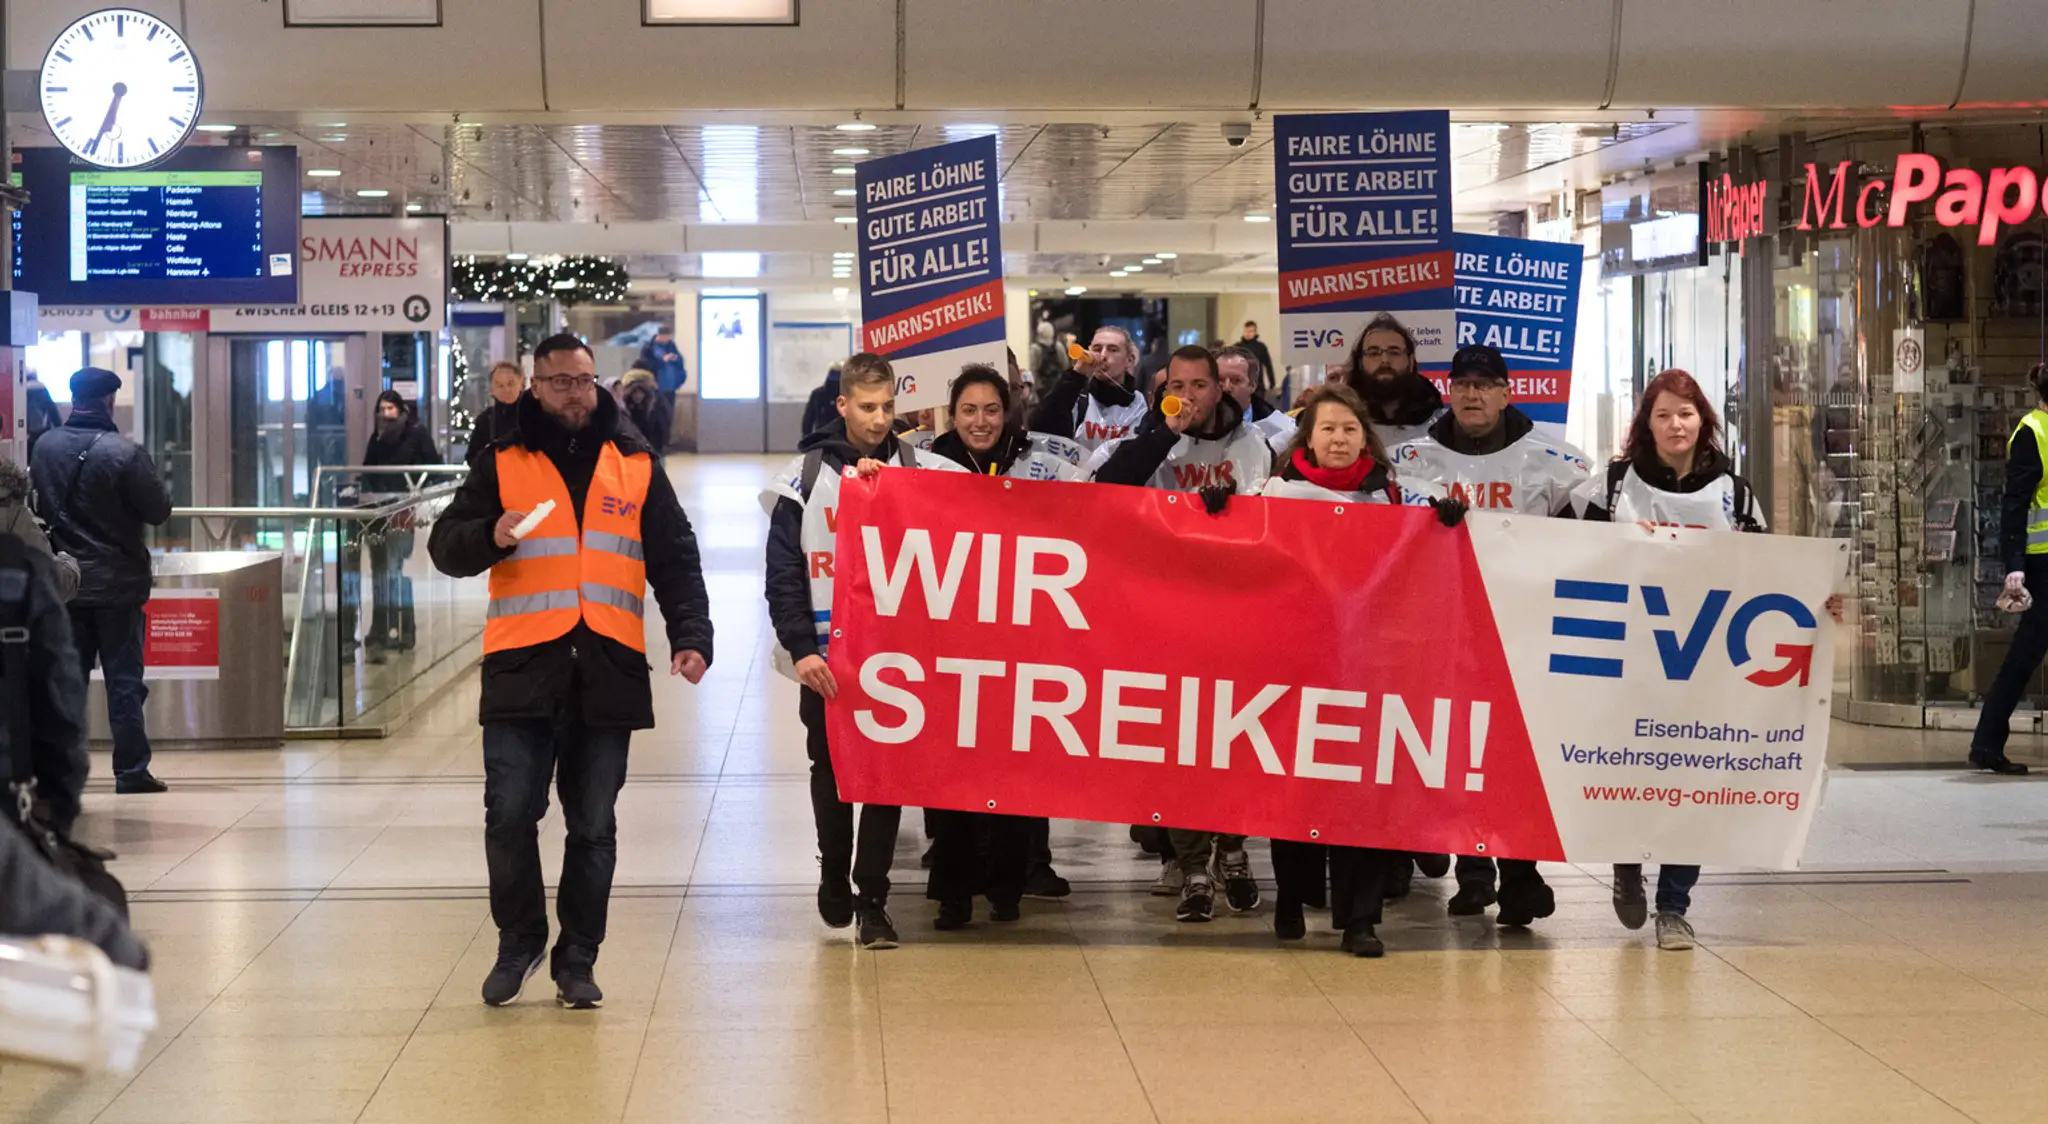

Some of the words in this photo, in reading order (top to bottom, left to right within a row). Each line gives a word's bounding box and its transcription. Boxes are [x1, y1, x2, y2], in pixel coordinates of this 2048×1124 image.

[1288, 135, 1351, 156] FAIRE
[1358, 128, 1436, 154] LÖHNE
[166, 186, 203, 194] Paderborn
[866, 173, 916, 204] FAIRE
[921, 159, 985, 192] LÖHNE
[1288, 172, 1349, 193] GUTE
[1355, 169, 1438, 191] ARBEIT
[166, 198, 193, 206] Hameln
[1797, 153, 2048, 246] McPap
[166, 210, 198, 219] Nienburg
[255, 209, 261, 217] 2
[867, 212, 916, 241] GUTE
[920, 197, 987, 230] ARBEIT
[1290, 204, 1349, 238] FÜR
[1355, 208, 1438, 236] ALLE!
[1706, 173, 1767, 258] McPaper
[166, 233, 187, 241] Haste
[166, 244, 185, 252] Celle
[252, 244, 261, 252] 14
[302, 237, 418, 262] SMANN
[166, 268, 200, 276] Hannover
[255, 268, 261, 276] 2
[339, 263, 418, 277] EXPRESS
[870, 249, 917, 286] FÜR
[921, 237, 989, 276] ALLE!
[1454, 252, 1489, 272] IRE
[1495, 252, 1569, 280] LÖHNE
[1288, 260, 1441, 298] WARNSTREIK!
[310, 304, 349, 316] GLEIS
[355, 304, 368, 316] 12
[382, 304, 395, 316] 13
[1454, 286, 1483, 305] TE
[1487, 289, 1567, 313] ARBEIT
[870, 292, 992, 348] WARNSTREIK!
[1294, 329, 1344, 348] EVG
[1483, 324, 1562, 354] ALLE!
[1172, 460, 1234, 489] WIR
[861, 525, 1091, 630] WIR
[1549, 579, 1817, 687] EVG
[853, 651, 1491, 792] STREIKEN!
[1634, 719, 1759, 742] Eisenbahn-
[1766, 725, 1805, 742] und
[1561, 744, 1802, 770] Verkehrsgewerkschaft
[1583, 786, 1799, 810] www.evg-online.org
